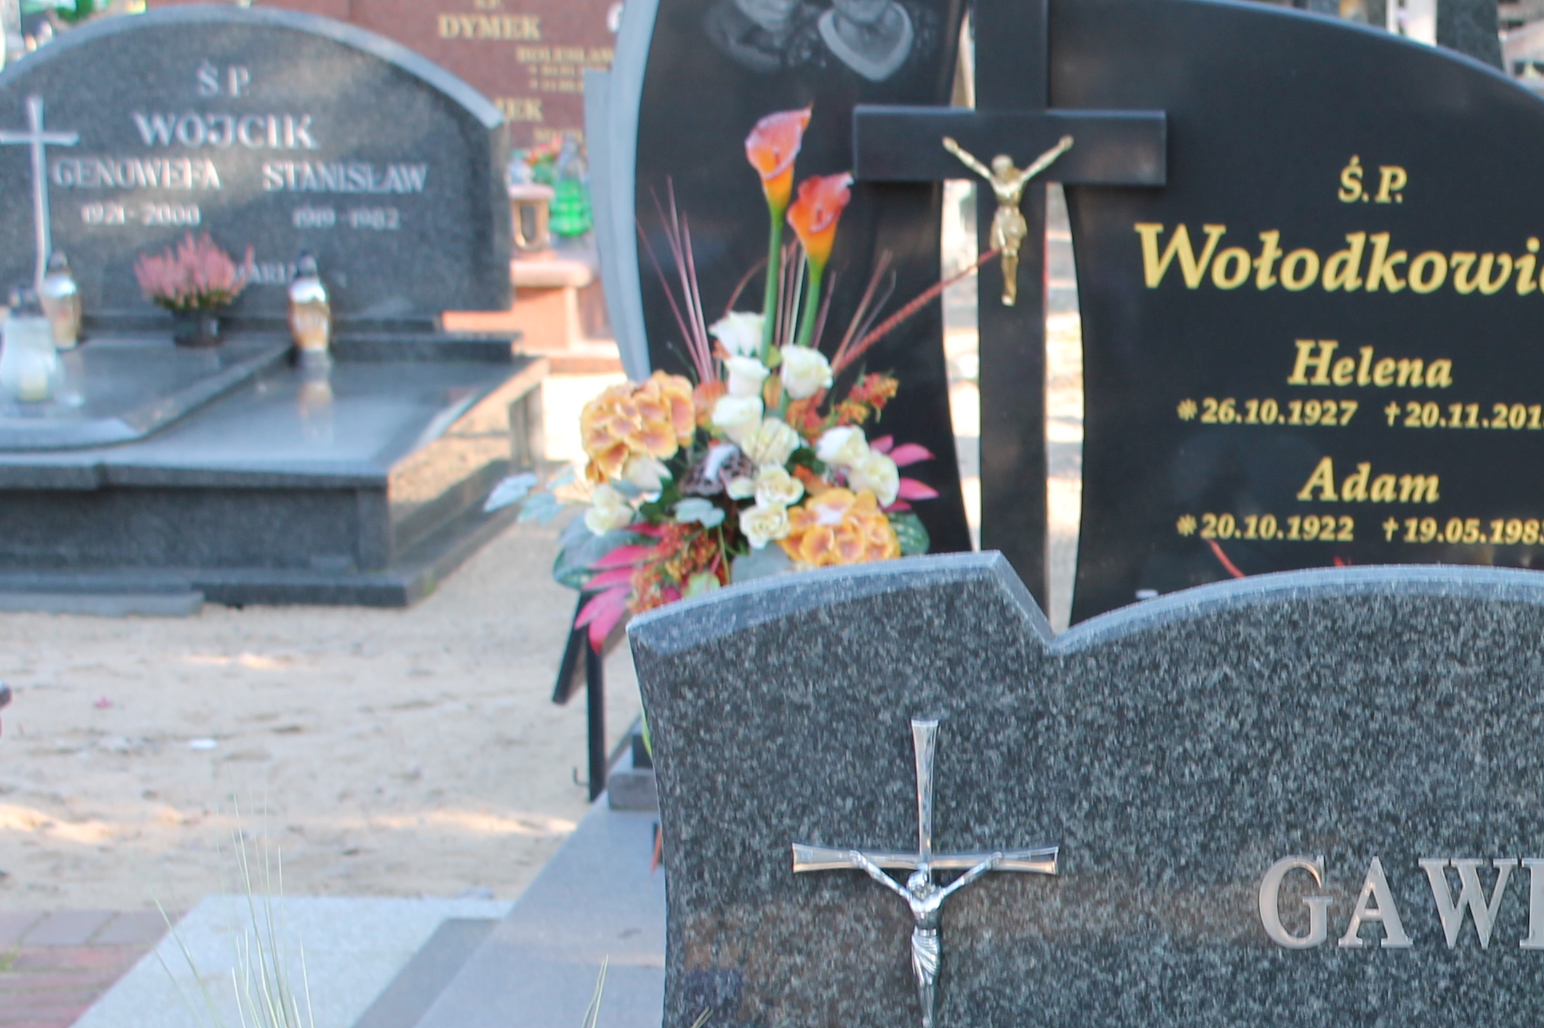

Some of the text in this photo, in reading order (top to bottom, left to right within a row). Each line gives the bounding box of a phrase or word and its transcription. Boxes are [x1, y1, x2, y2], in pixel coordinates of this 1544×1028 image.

[438, 14, 542, 40] DYMEK
[52, 157, 428, 193] GENOWEFA STANISŁAW
[1287, 339, 1453, 388] Helena
[1200, 398, 1358, 426] 26.10.1927
[1297, 456, 1440, 503] Adam
[1200, 513, 1355, 542] 20.10.1922
